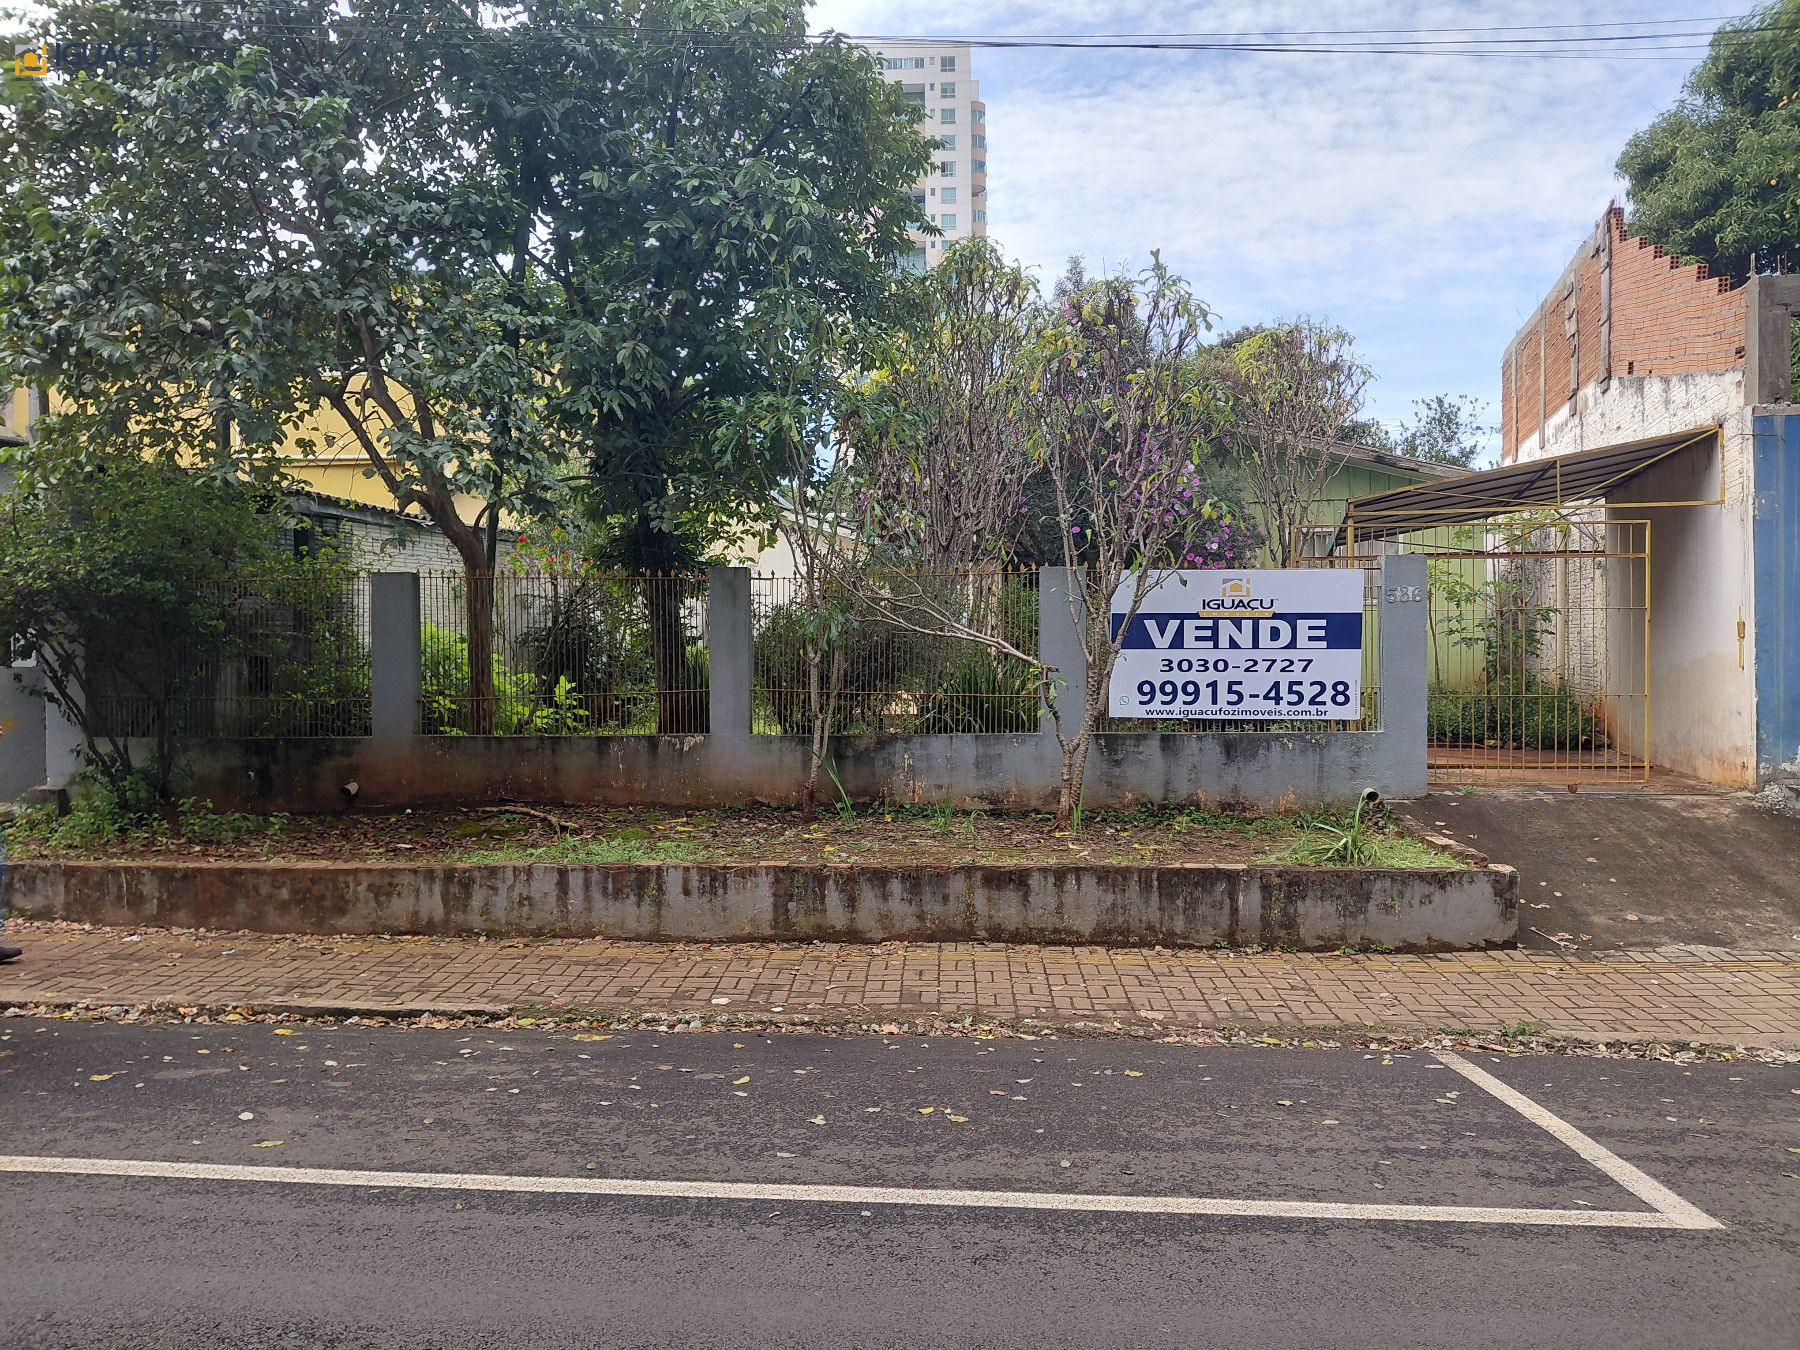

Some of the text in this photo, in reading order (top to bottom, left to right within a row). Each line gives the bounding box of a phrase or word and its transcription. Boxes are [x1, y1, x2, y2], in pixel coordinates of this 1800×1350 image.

[1387, 585, 1422, 603] 586
[1202, 598, 1274, 611] IGUAÇU
[1143, 619, 1328, 649] VENDE
[1159, 658, 1314, 673] 3030-2727
[1136, 679, 1351, 706] 99915-4528
[1145, 707, 1329, 718] www.iguacufozimoveis.com.br
